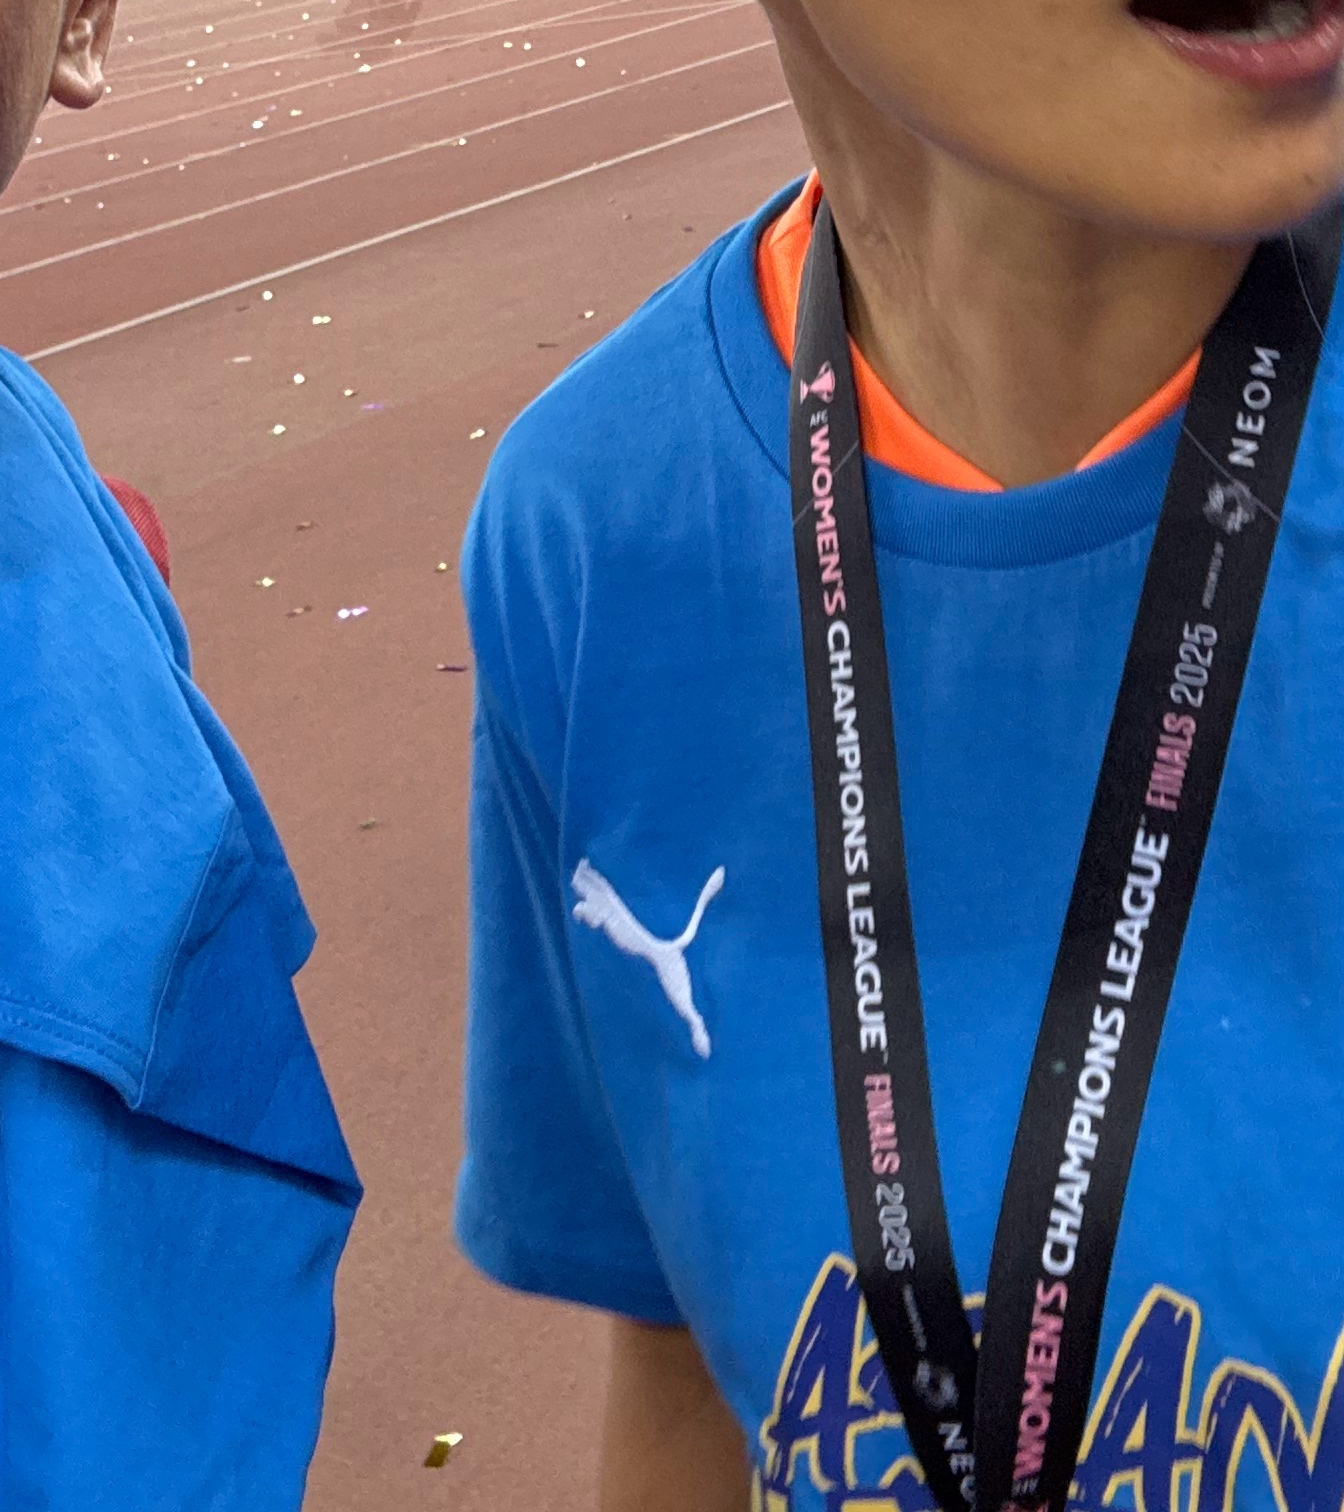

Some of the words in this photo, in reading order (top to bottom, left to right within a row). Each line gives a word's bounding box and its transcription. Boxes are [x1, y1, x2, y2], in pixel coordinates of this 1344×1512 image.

[809, 408, 829, 428] AFC
[1227, 346, 1281, 469] NEOM
[809, 423, 847, 616] WOMEN'S
[1169, 620, 1219, 708] 2025
[827, 619, 869, 877] CHAMPIONS
[1144, 711, 1197, 813] FINALS
[846, 881, 888, 1055] LEAGUE
[1100, 825, 1170, 1003] LEAGUE
[863, 1073, 901, 1176] FINALS
[1041, 1003, 1126, 1277] CHAMPIONS
[875, 1182, 916, 1272] 2025
